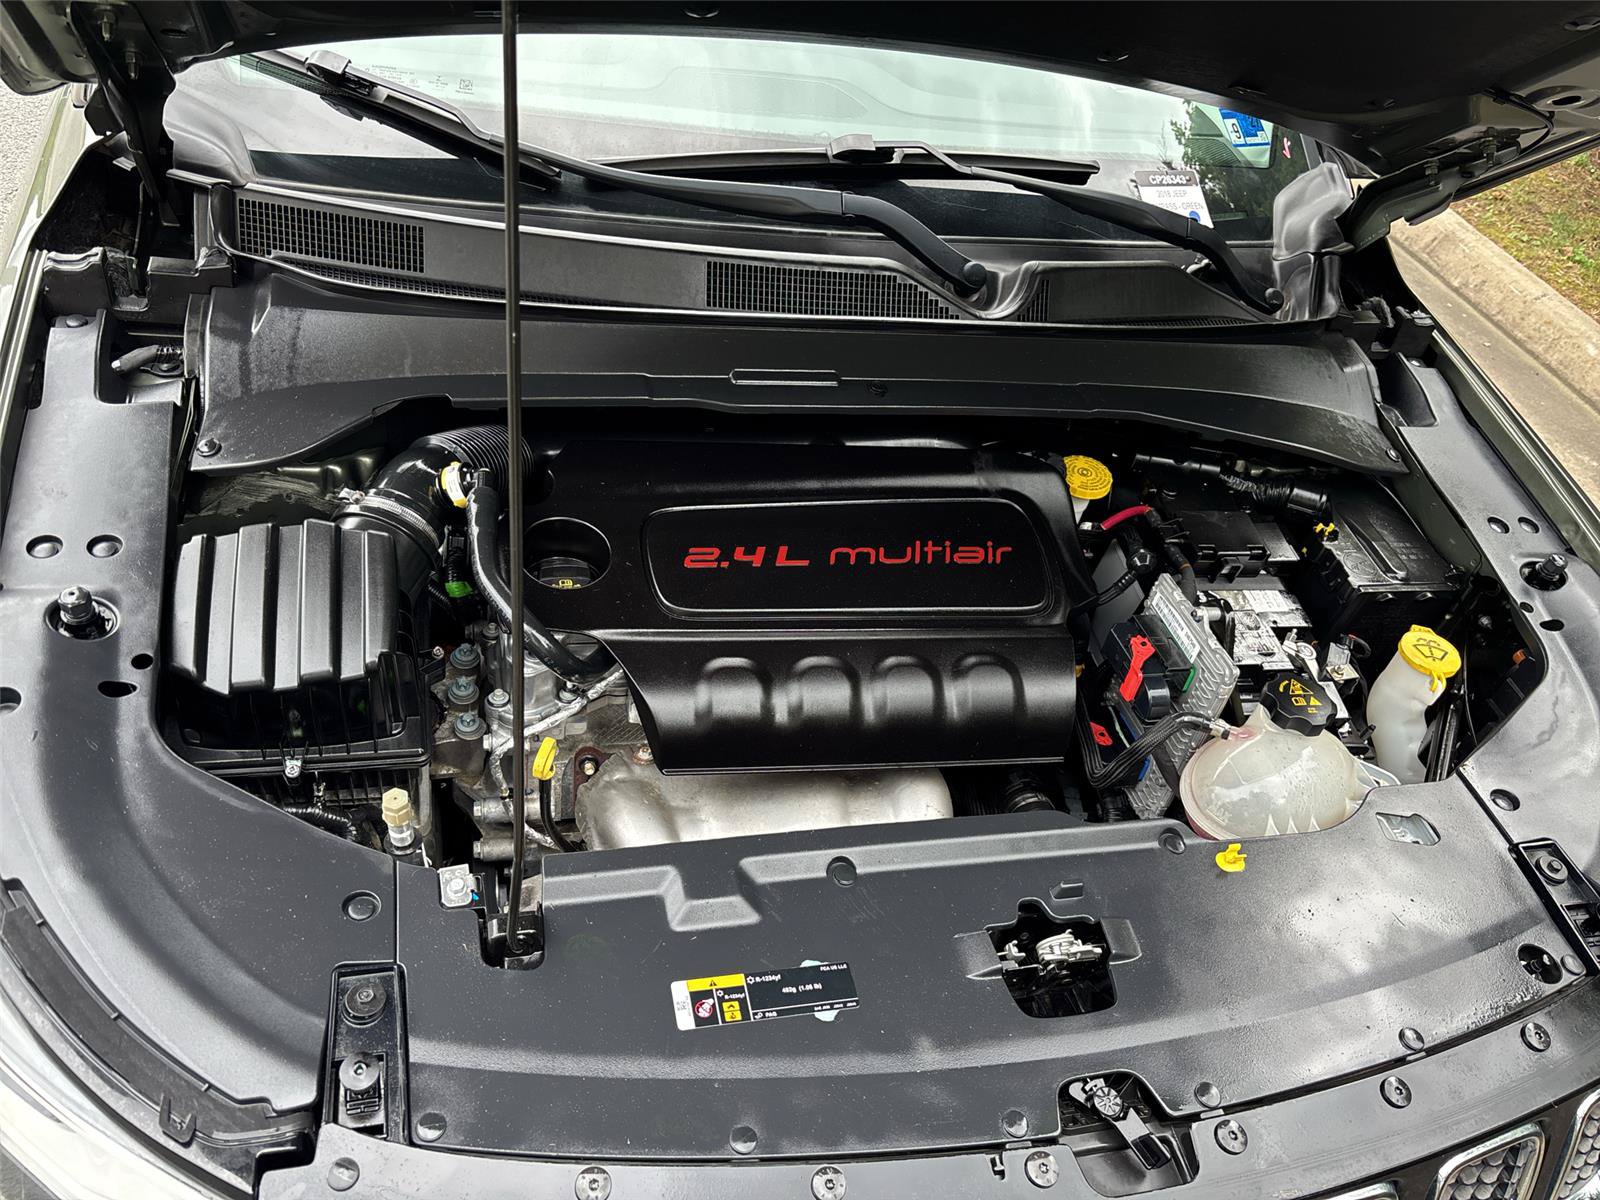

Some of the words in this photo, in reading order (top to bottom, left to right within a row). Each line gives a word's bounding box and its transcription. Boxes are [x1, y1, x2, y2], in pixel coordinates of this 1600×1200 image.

[1231, 123, 1242, 139] 9
[1171, 189, 1187, 198] JEEP
[1181, 201, 1204, 211] GREEN
[829, 540, 1012, 565] multiair
